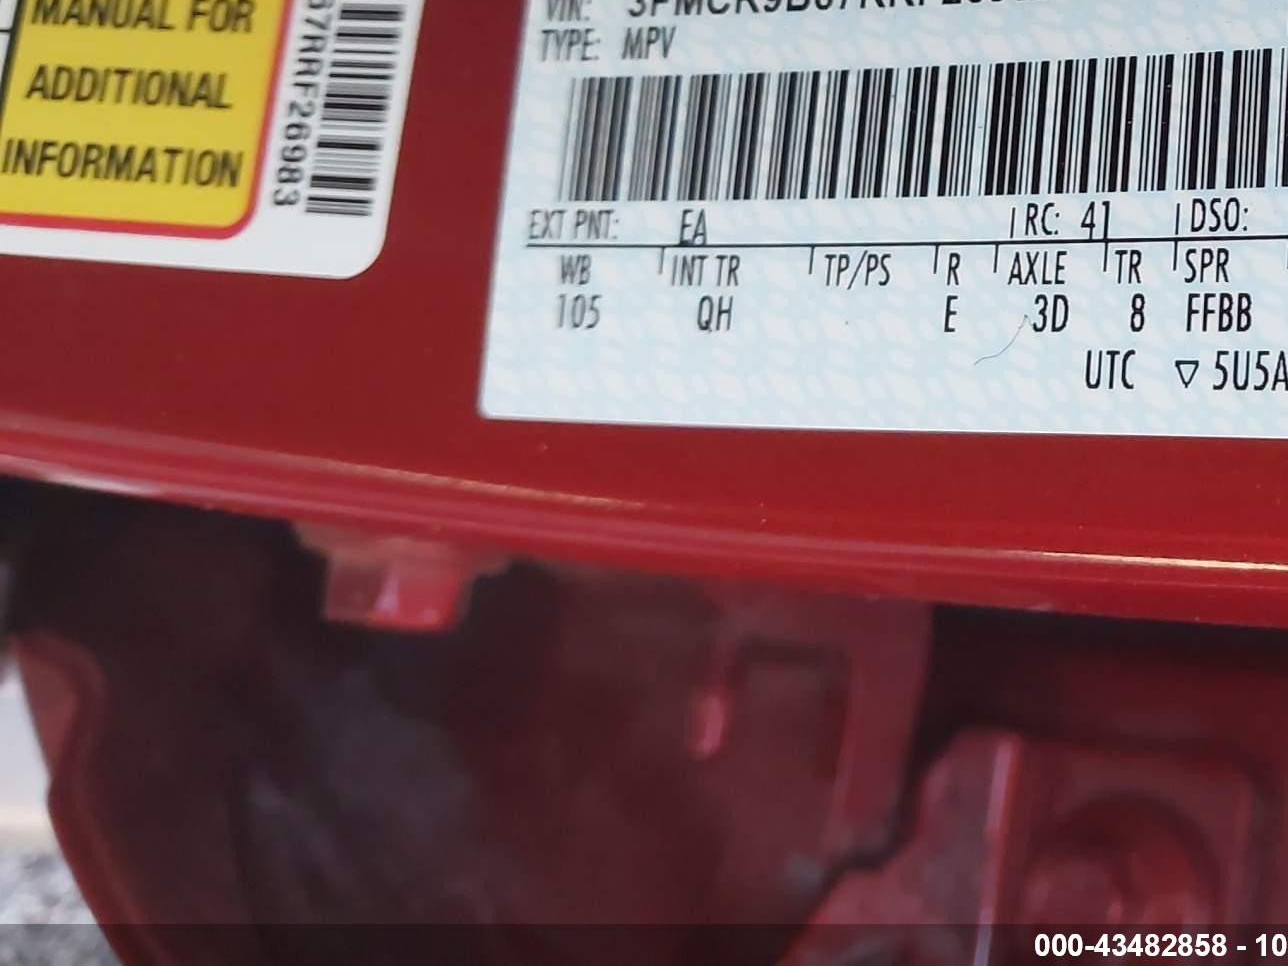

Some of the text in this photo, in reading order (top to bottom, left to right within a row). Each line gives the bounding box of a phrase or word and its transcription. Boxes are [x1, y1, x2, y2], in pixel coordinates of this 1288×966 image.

[540, 26, 677, 62] TYPE: MPV
[26, 65, 233, 110] ADDITIONAL
[0, 141, 244, 187] INFORMATION
[528, 208, 621, 240] EXT PNT:
[679, 208, 709, 245] EA
[1025, 202, 1110, 240] RC: 41
[1190, 197, 1249, 233] DSO:
[560, 253, 593, 286] WB
[670, 253, 742, 287] INT TR
[824, 252, 893, 289] TP/PS
[946, 252, 962, 286] R
[1007, 250, 1068, 286] AXLE
[1114, 248, 1143, 284] TR
[1184, 247, 1230, 284] SPR
[555, 294, 602, 329] 105
[697, 295, 734, 332] QH
[943, 294, 958, 333] E
[1032, 293, 1069, 333] 3D
[1130, 293, 1146, 332] 8
[1186, 292, 1253, 333] FFBB
[1084, 349, 1136, 391] UTC
